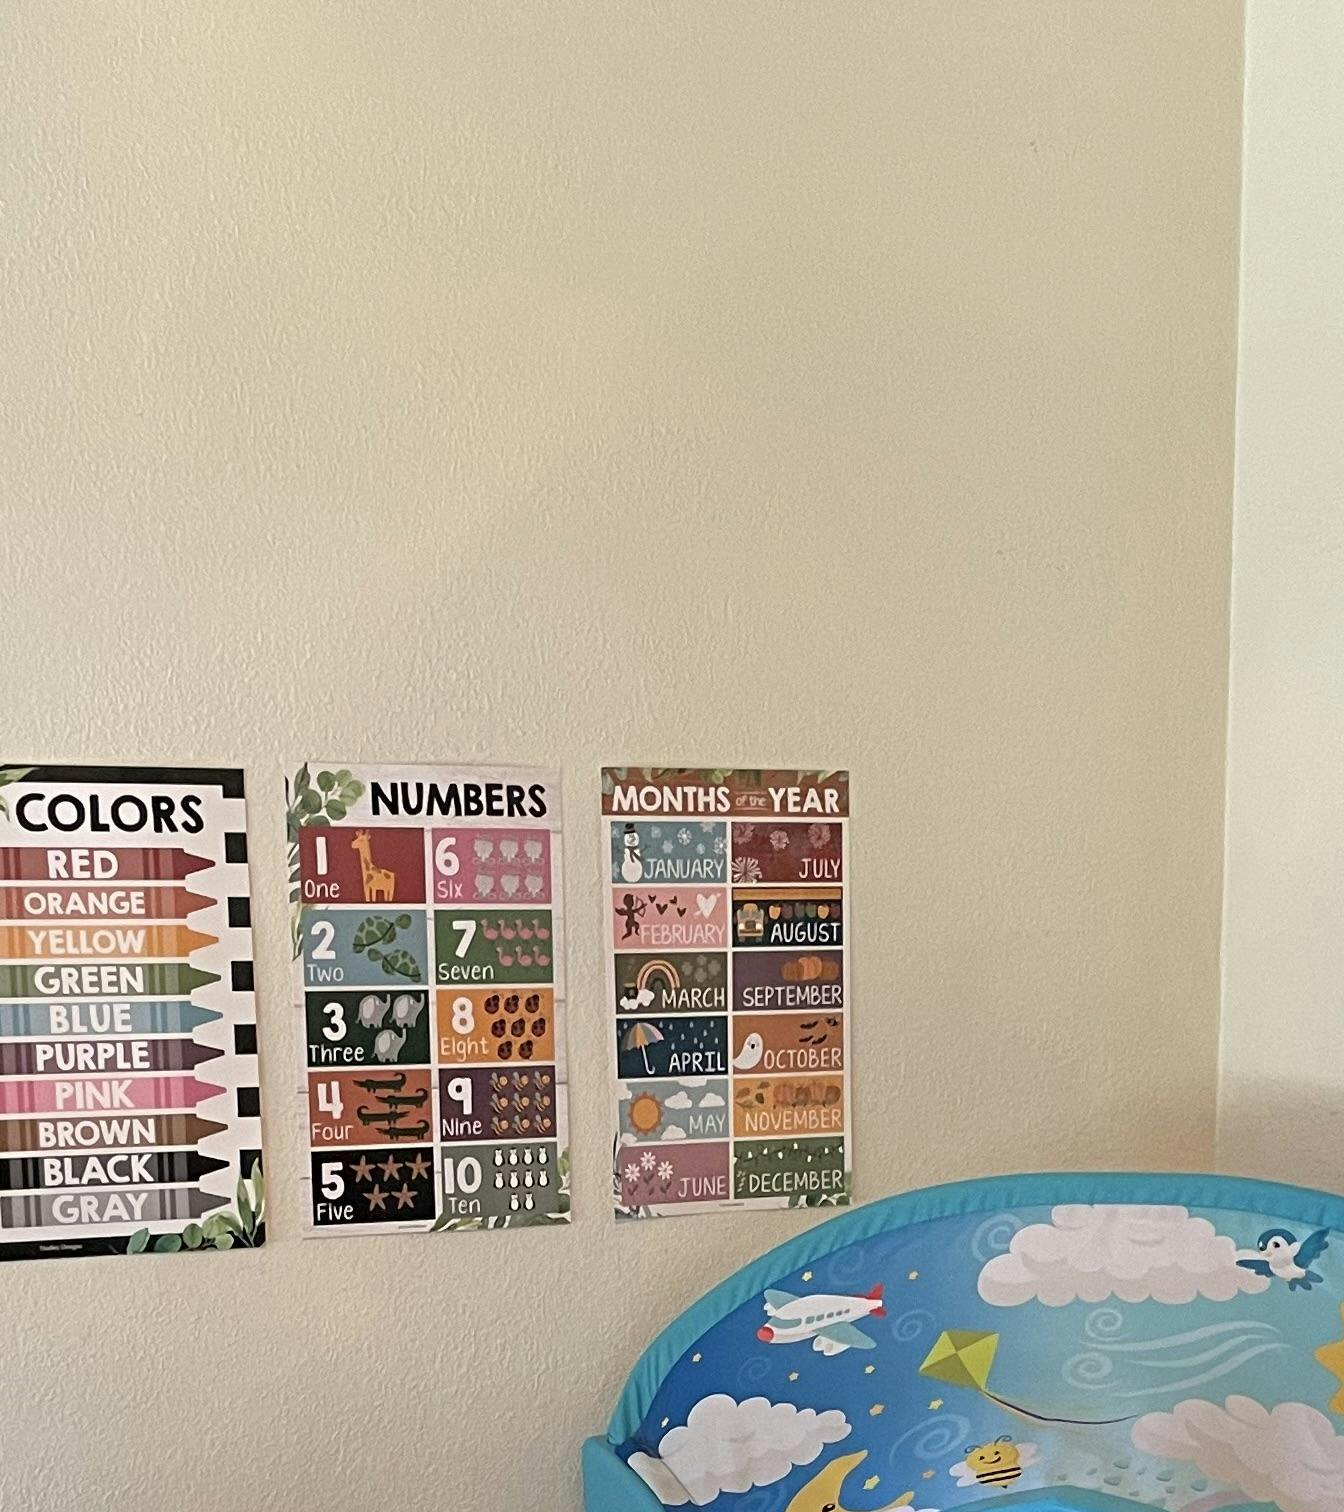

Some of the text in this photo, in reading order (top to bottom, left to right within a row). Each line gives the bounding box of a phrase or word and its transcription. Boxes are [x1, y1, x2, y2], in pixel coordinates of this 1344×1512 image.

[371, 782, 547, 818] NUMBERS
[612, 786, 839, 813] MONTHS of the YEAR
[16, 793, 205, 834] COLORS
[48, 848, 119, 879] RED
[315, 837, 328, 875] 1
[435, 837, 460, 876] 6
[644, 858, 725, 879] JANUARY
[799, 858, 841, 880] JULY
[305, 879, 339, 898] One
[24, 891, 145, 915] ORANGE
[28, 928, 145, 955] YELLOW
[311, 921, 336, 960] 2
[452, 920, 476, 958] 7
[641, 924, 725, 944] FEBRUARY
[770, 922, 840, 943] AUGUST
[35, 965, 144, 994] GREEN
[308, 963, 344, 982] Two
[438, 962, 494, 980] Seven
[662, 987, 725, 1008] MARCH
[743, 985, 842, 1007] SEPTEMBER
[50, 1004, 132, 1035] BLUE
[323, 1002, 346, 1041] 3
[452, 997, 475, 1034] 8
[36, 1041, 150, 1072] PURPLE
[309, 1044, 364, 1062] Three
[668, 1051, 726, 1073] APRIL
[763, 1048, 841, 1069] OCTOBER
[56, 1078, 135, 1110] PINK
[318, 1081, 343, 1120] 4
[448, 1077, 472, 1115] 9
[39, 1117, 155, 1148] BROWN
[312, 1123, 354, 1140] Four
[688, 1114, 726, 1133] MAY
[745, 1109, 842, 1131] NOVEMBER
[44, 1154, 153, 1186] BLACK
[321, 1162, 345, 1199] 5
[444, 1157, 482, 1194] 10
[749, 1171, 842, 1192] DECEMBER
[678, 1176, 726, 1197] JUNE
[53, 1193, 148, 1224] GRAY
[449, 1198, 481, 1215] Ten
